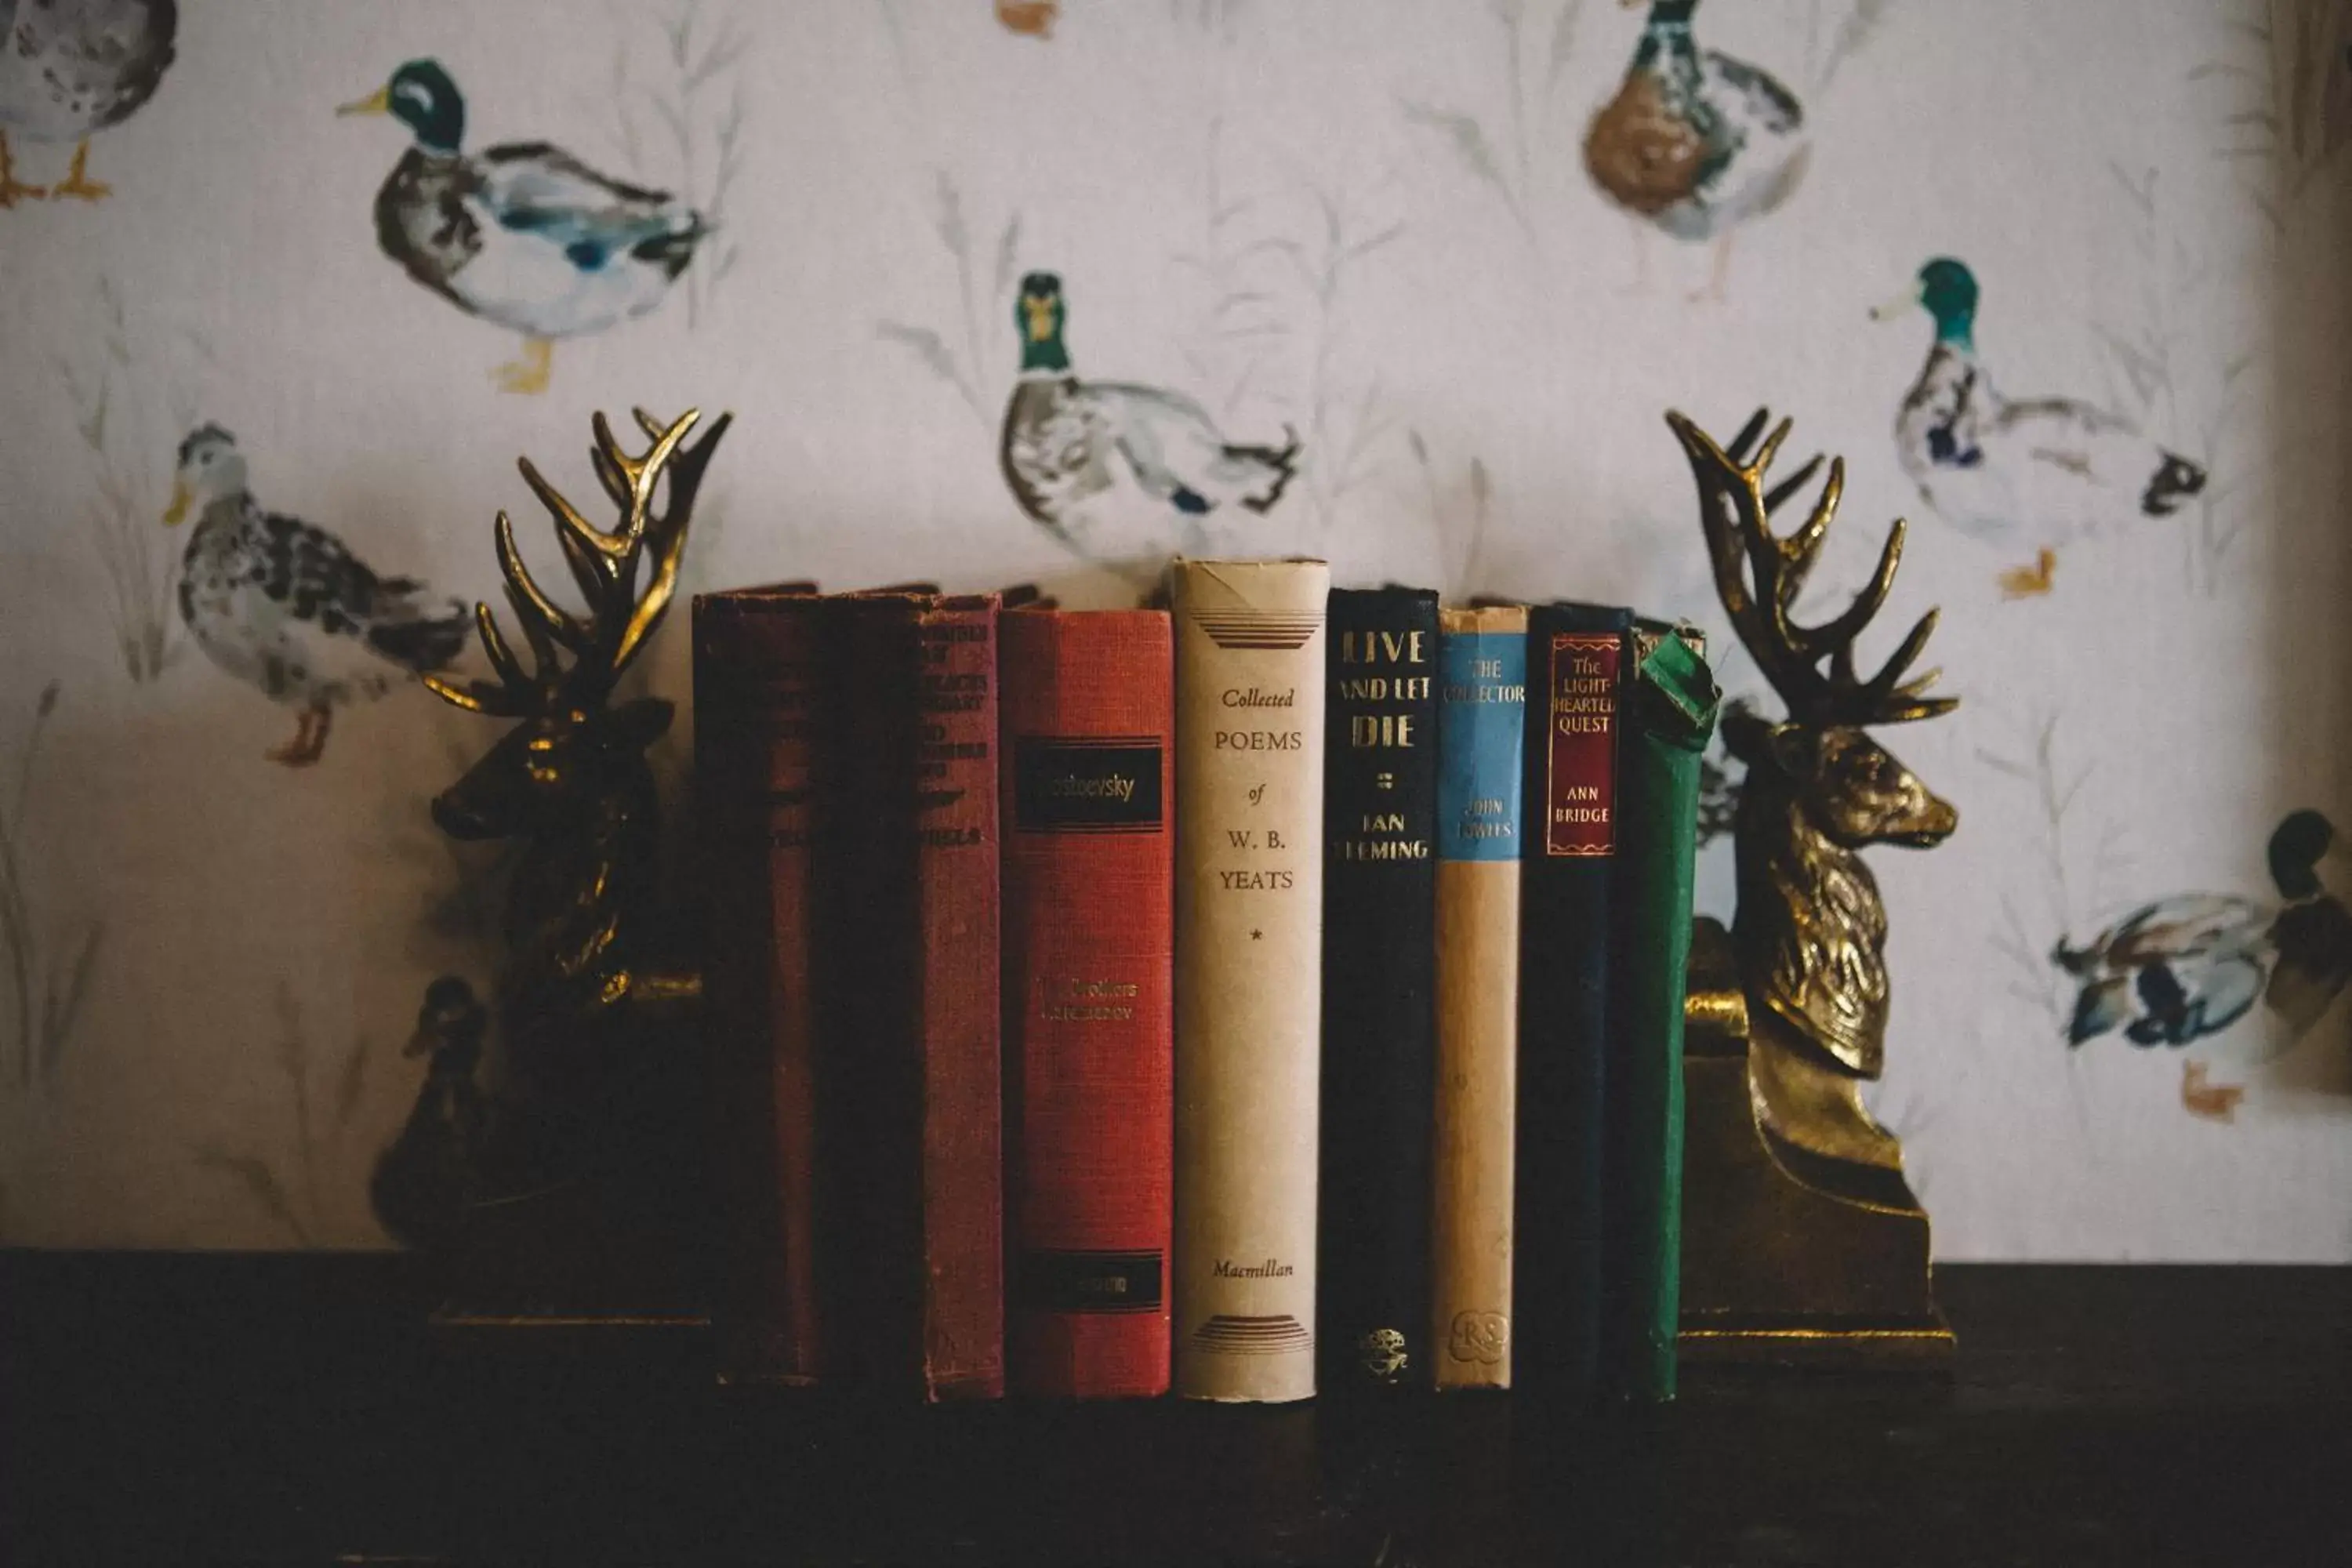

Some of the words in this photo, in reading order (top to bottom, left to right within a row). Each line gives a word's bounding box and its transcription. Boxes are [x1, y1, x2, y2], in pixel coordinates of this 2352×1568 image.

[1343, 630, 1426, 663] LIVE
[1468, 659, 1501, 678] THE
[1573, 656, 1602, 674] The
[1340, 678, 1388, 700] AND
[1394, 677, 1432, 700] LET
[1563, 678, 1611, 694] LIGHT-
[1221, 688, 1296, 708] Collected
[1352, 714, 1415, 748] DIE
[1559, 717, 1610, 735] QUEST
[1215, 731, 1303, 751] POEMS
[1249, 783, 1268, 807] of
[1567, 786, 1599, 800] ANN
[1465, 799, 1504, 815] JOHN
[1555, 808, 1610, 823] BRIDGE
[1363, 814, 1405, 832] IAN
[1227, 829, 1258, 849] W.
[1267, 829, 1287, 849] B.
[1335, 840, 1428, 861] LEMING
[1220, 870, 1294, 890] YEATS
[1213, 1258, 1294, 1278] Macmillan
